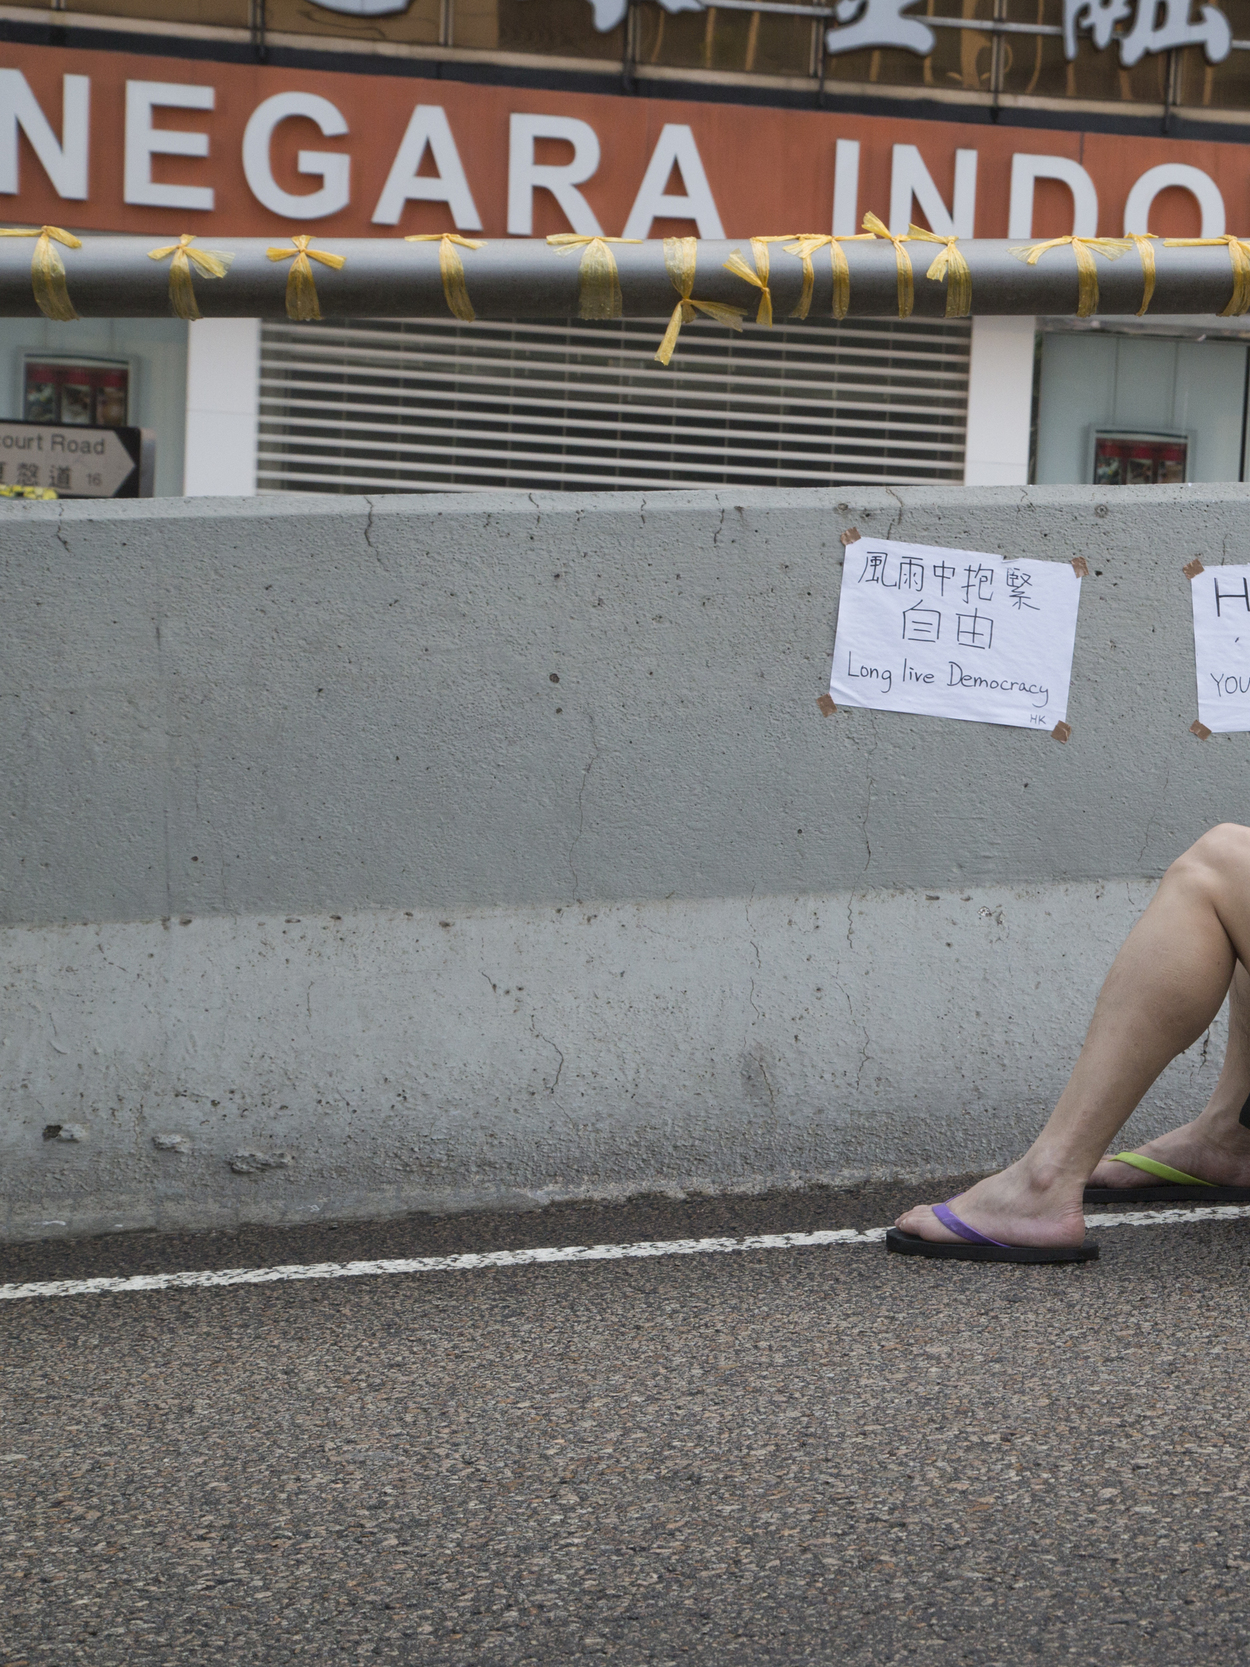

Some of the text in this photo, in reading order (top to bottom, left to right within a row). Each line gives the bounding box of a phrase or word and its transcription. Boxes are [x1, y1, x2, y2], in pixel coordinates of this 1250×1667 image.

[0, 68, 728, 240] NEGARA
[0, 433, 105, 455] ourt Road
[86, 473, 103, 487] 16
[857, 551, 1040, 611] 風雨中抱緊
[902, 599, 994, 650] 自由
[847, 650, 1050, 708] Long live Democracy
[1029, 713, 1047, 726] HK
